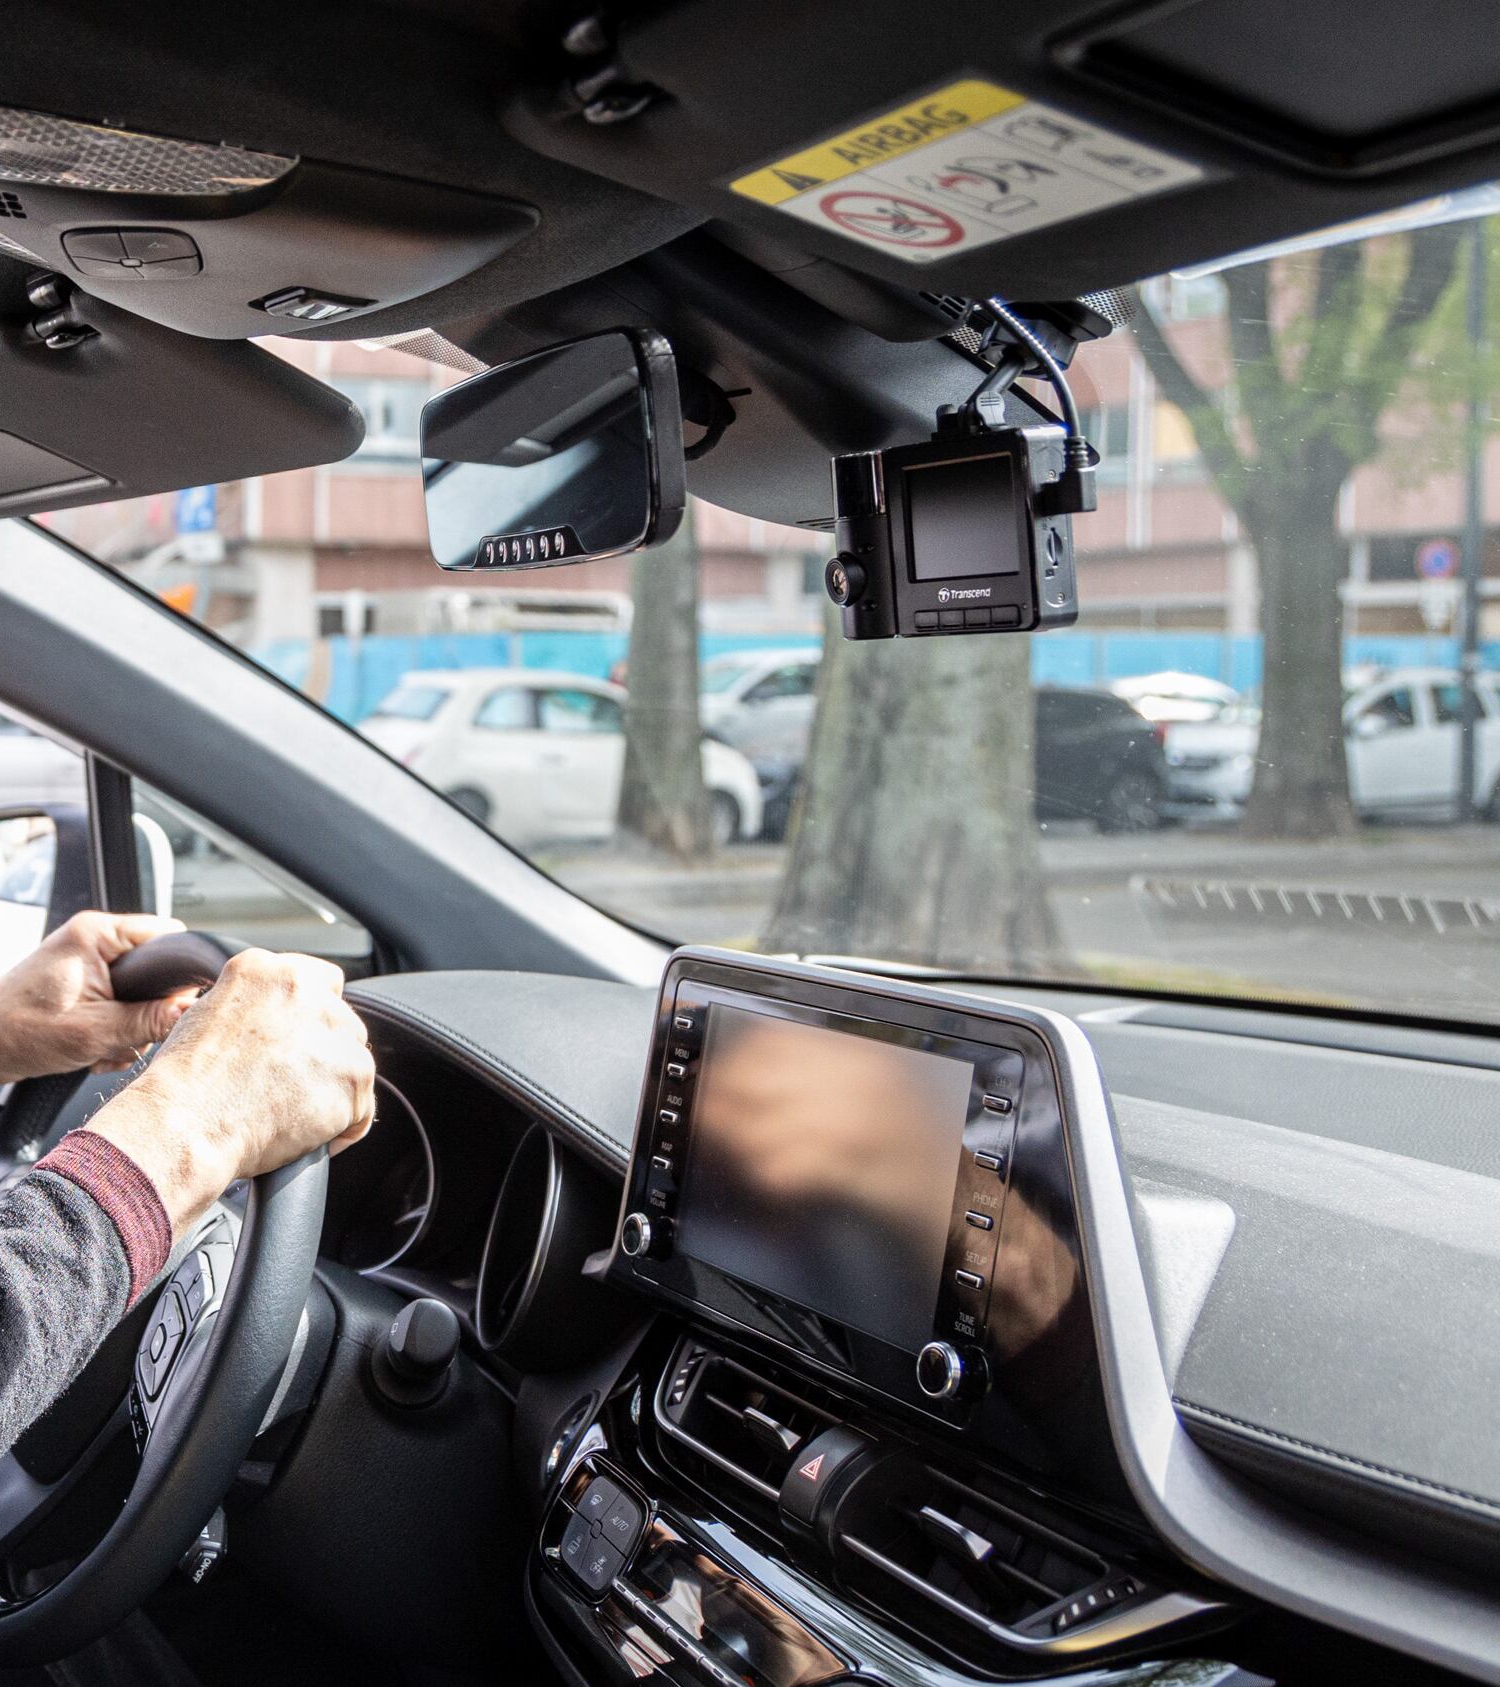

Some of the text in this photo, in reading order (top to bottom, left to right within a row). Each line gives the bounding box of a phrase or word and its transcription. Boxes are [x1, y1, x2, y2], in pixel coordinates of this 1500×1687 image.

[831, 104, 970, 165] AIRBAG
[950, 588, 991, 600] Transcend
[674, 1047, 690, 1060] MENU
[667, 1094, 683, 1107] AUDIO
[661, 1141, 674, 1152] MAP
[972, 1191, 998, 1209] PHONE
[964, 1250, 988, 1265] SETUP
[959, 1311, 975, 1326] TUNE
[954, 1320, 976, 1338] SCROLL
[612, 1516, 629, 1532] AUTO
